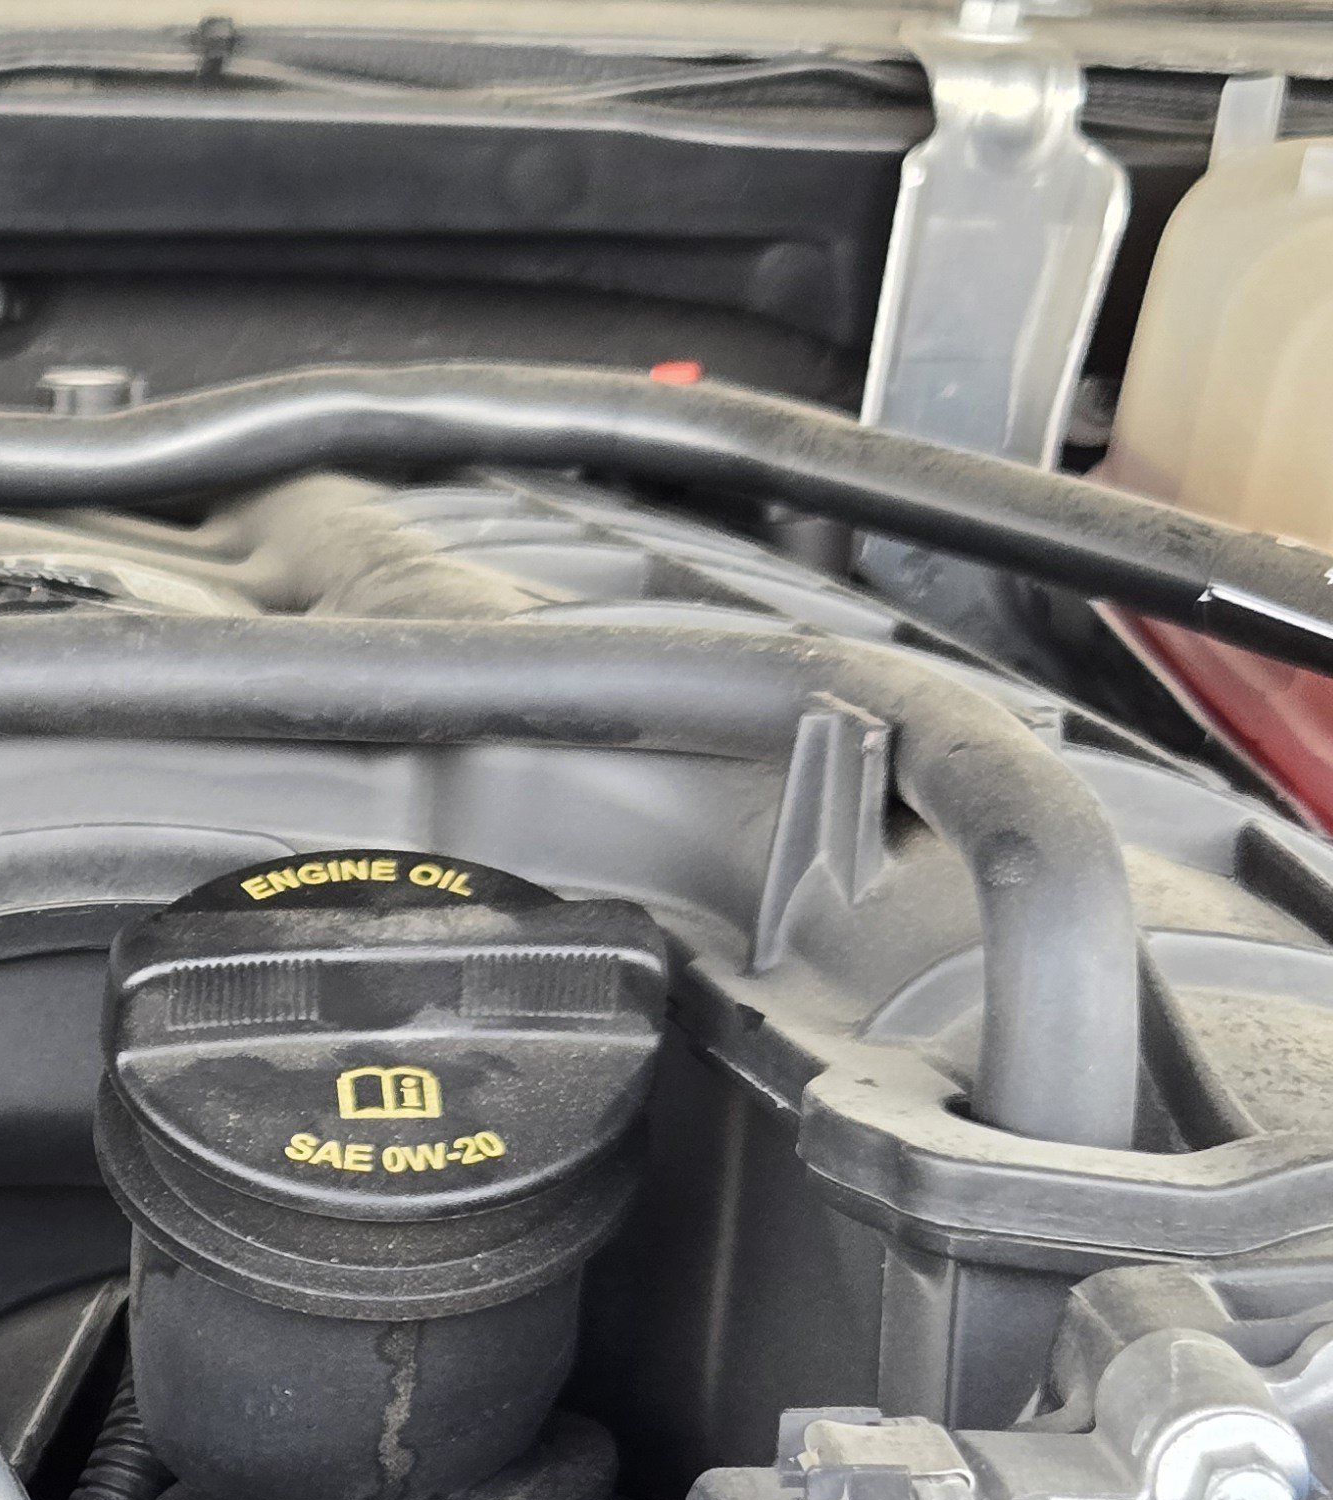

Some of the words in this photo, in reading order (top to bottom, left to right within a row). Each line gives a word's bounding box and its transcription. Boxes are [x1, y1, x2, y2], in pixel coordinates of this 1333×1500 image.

[240, 858, 397, 901] ENGINE
[408, 862, 474, 898] OIL
[284, 1131, 373, 1172] SAE
[381, 1129, 507, 1173] 0W-20
